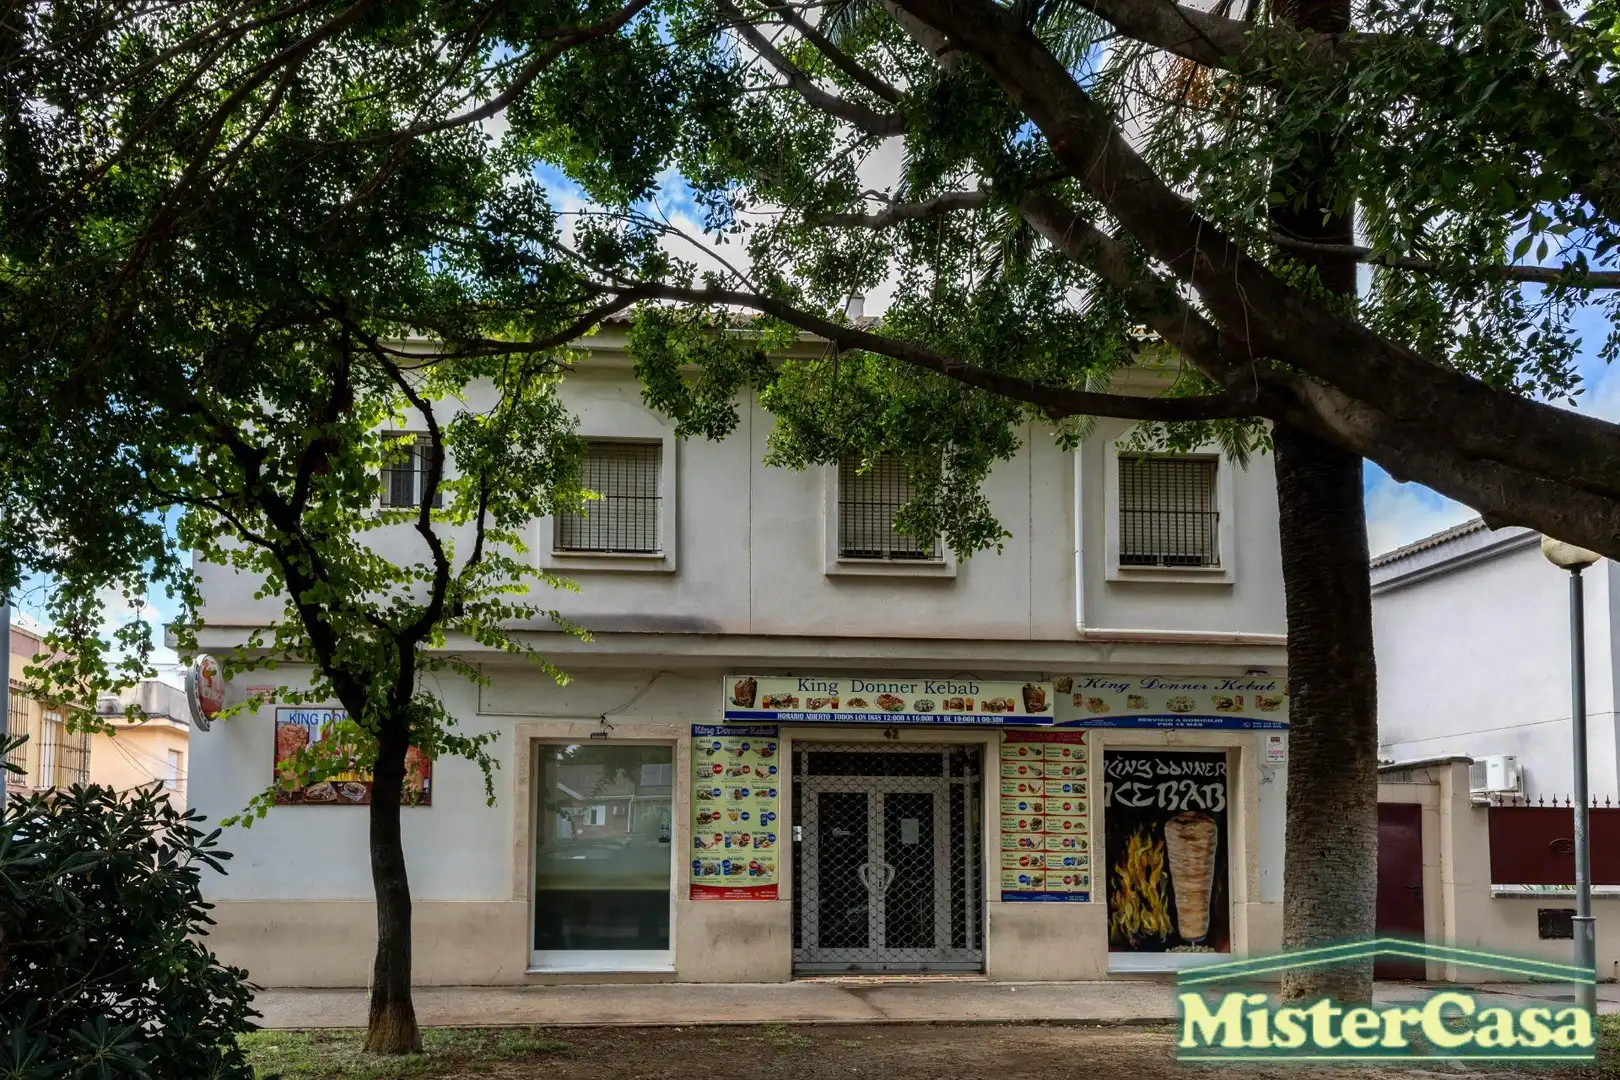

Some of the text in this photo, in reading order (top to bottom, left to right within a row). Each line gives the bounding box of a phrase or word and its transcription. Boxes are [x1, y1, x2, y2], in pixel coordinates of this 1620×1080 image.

[797, 678, 980, 695] King Donner Kebab
[1078, 677, 1277, 694] King Donner Kebab
[289, 713, 318, 725] KING
[777, 712, 804, 720] HORARIO
[805, 712, 831, 720] ABIERTO
[855, 713, 867, 721] LOS
